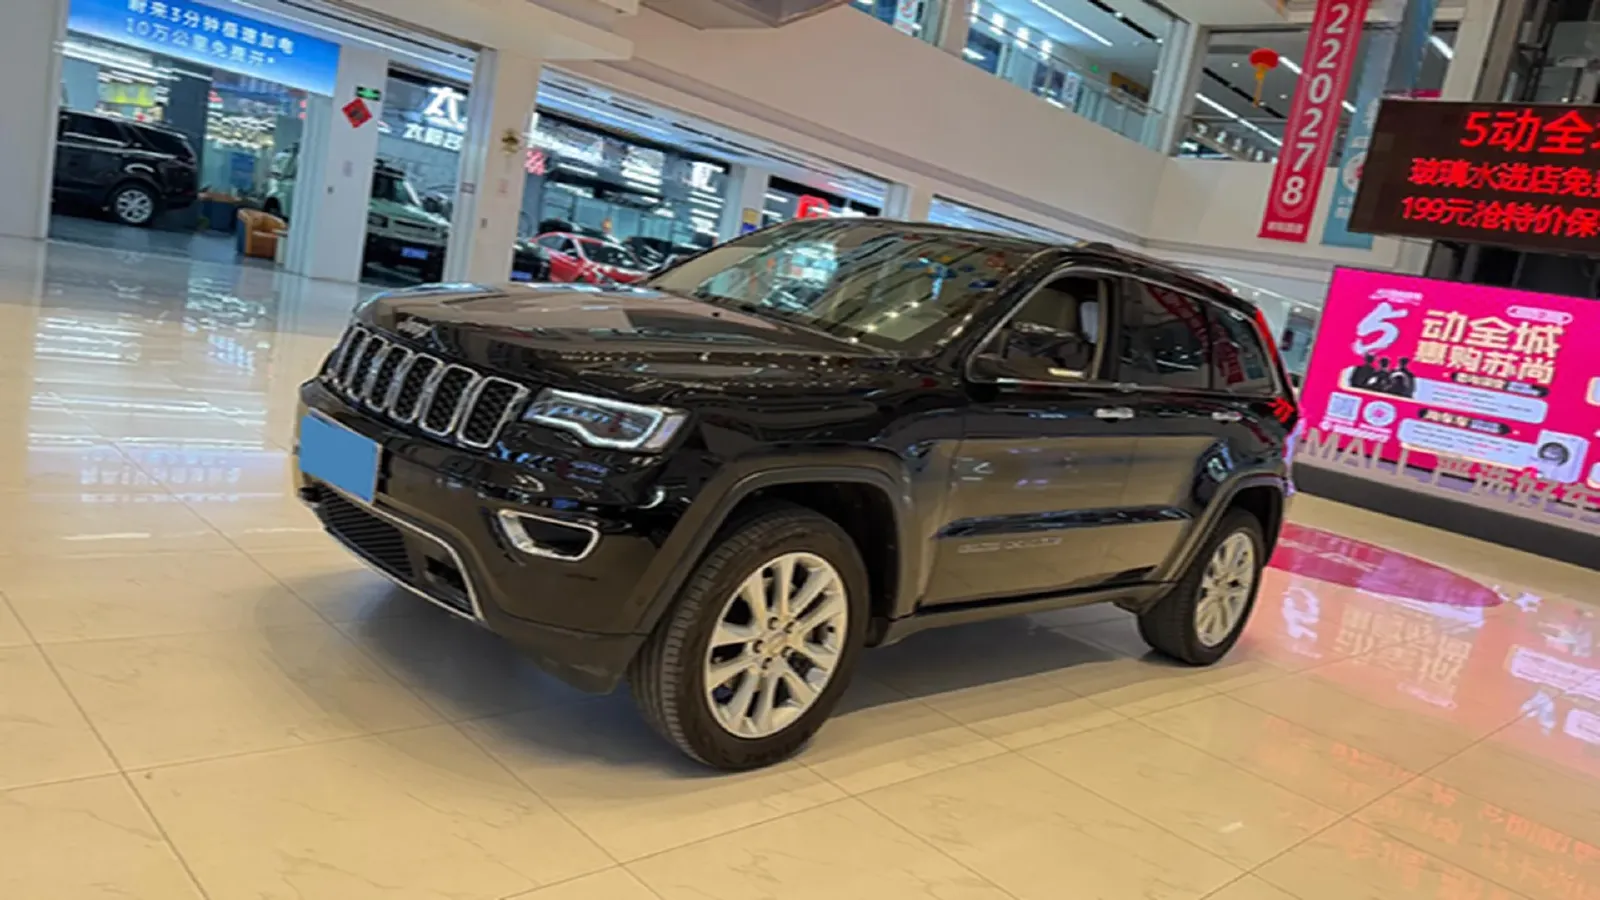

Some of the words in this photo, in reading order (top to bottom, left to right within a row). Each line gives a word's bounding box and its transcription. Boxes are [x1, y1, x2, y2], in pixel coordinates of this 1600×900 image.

[1460, 108, 1600, 155] 5动全
[1422, 309, 1563, 359] 动全城
